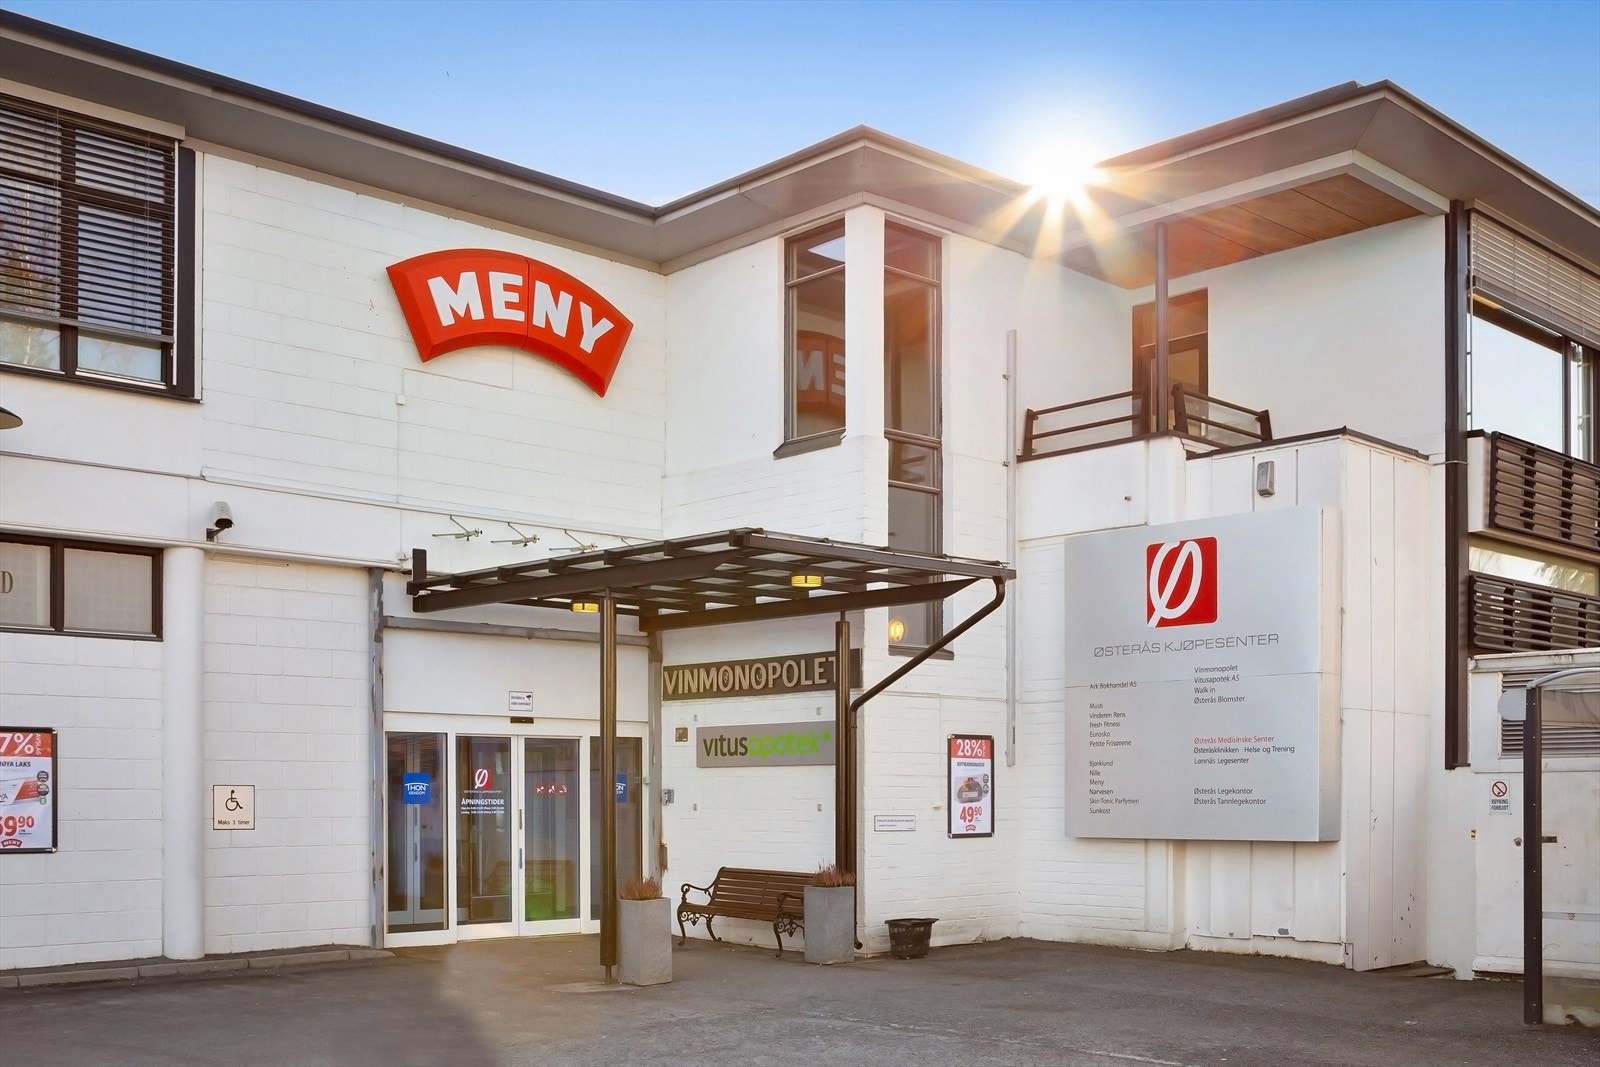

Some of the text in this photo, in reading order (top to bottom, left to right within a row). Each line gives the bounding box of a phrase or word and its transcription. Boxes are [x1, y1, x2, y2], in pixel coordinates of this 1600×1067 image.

[426, 271, 614, 354] MENY
[1093, 633, 1280, 658] ØSTERÅS KJØPESENTER
[1194, 664, 1239, 673] Vinmonopolet
[1194, 674, 1240, 684] Vitusapotek AS
[1194, 695, 1246, 704] Østerås Blomster
[1194, 735, 1275, 745] Østerås Medisinske Senter
[957, 739, 983, 757] 28%
[1262, 747, 1271, 755] og
[1272, 745, 1295, 754] Trening
[1217, 757, 1250, 766] Legesenter
[404, 782, 429, 791] THON
[1089, 779, 1105, 787] Meny
[1194, 787, 1254, 796] Østerås Legekontor
[461, 797, 505, 805] ÅPNINGSTIDER
[1194, 797, 1267, 807] Østerås Tannlegekontor
[960, 806, 974, 823] 49
[18, 815, 35, 828] 90
